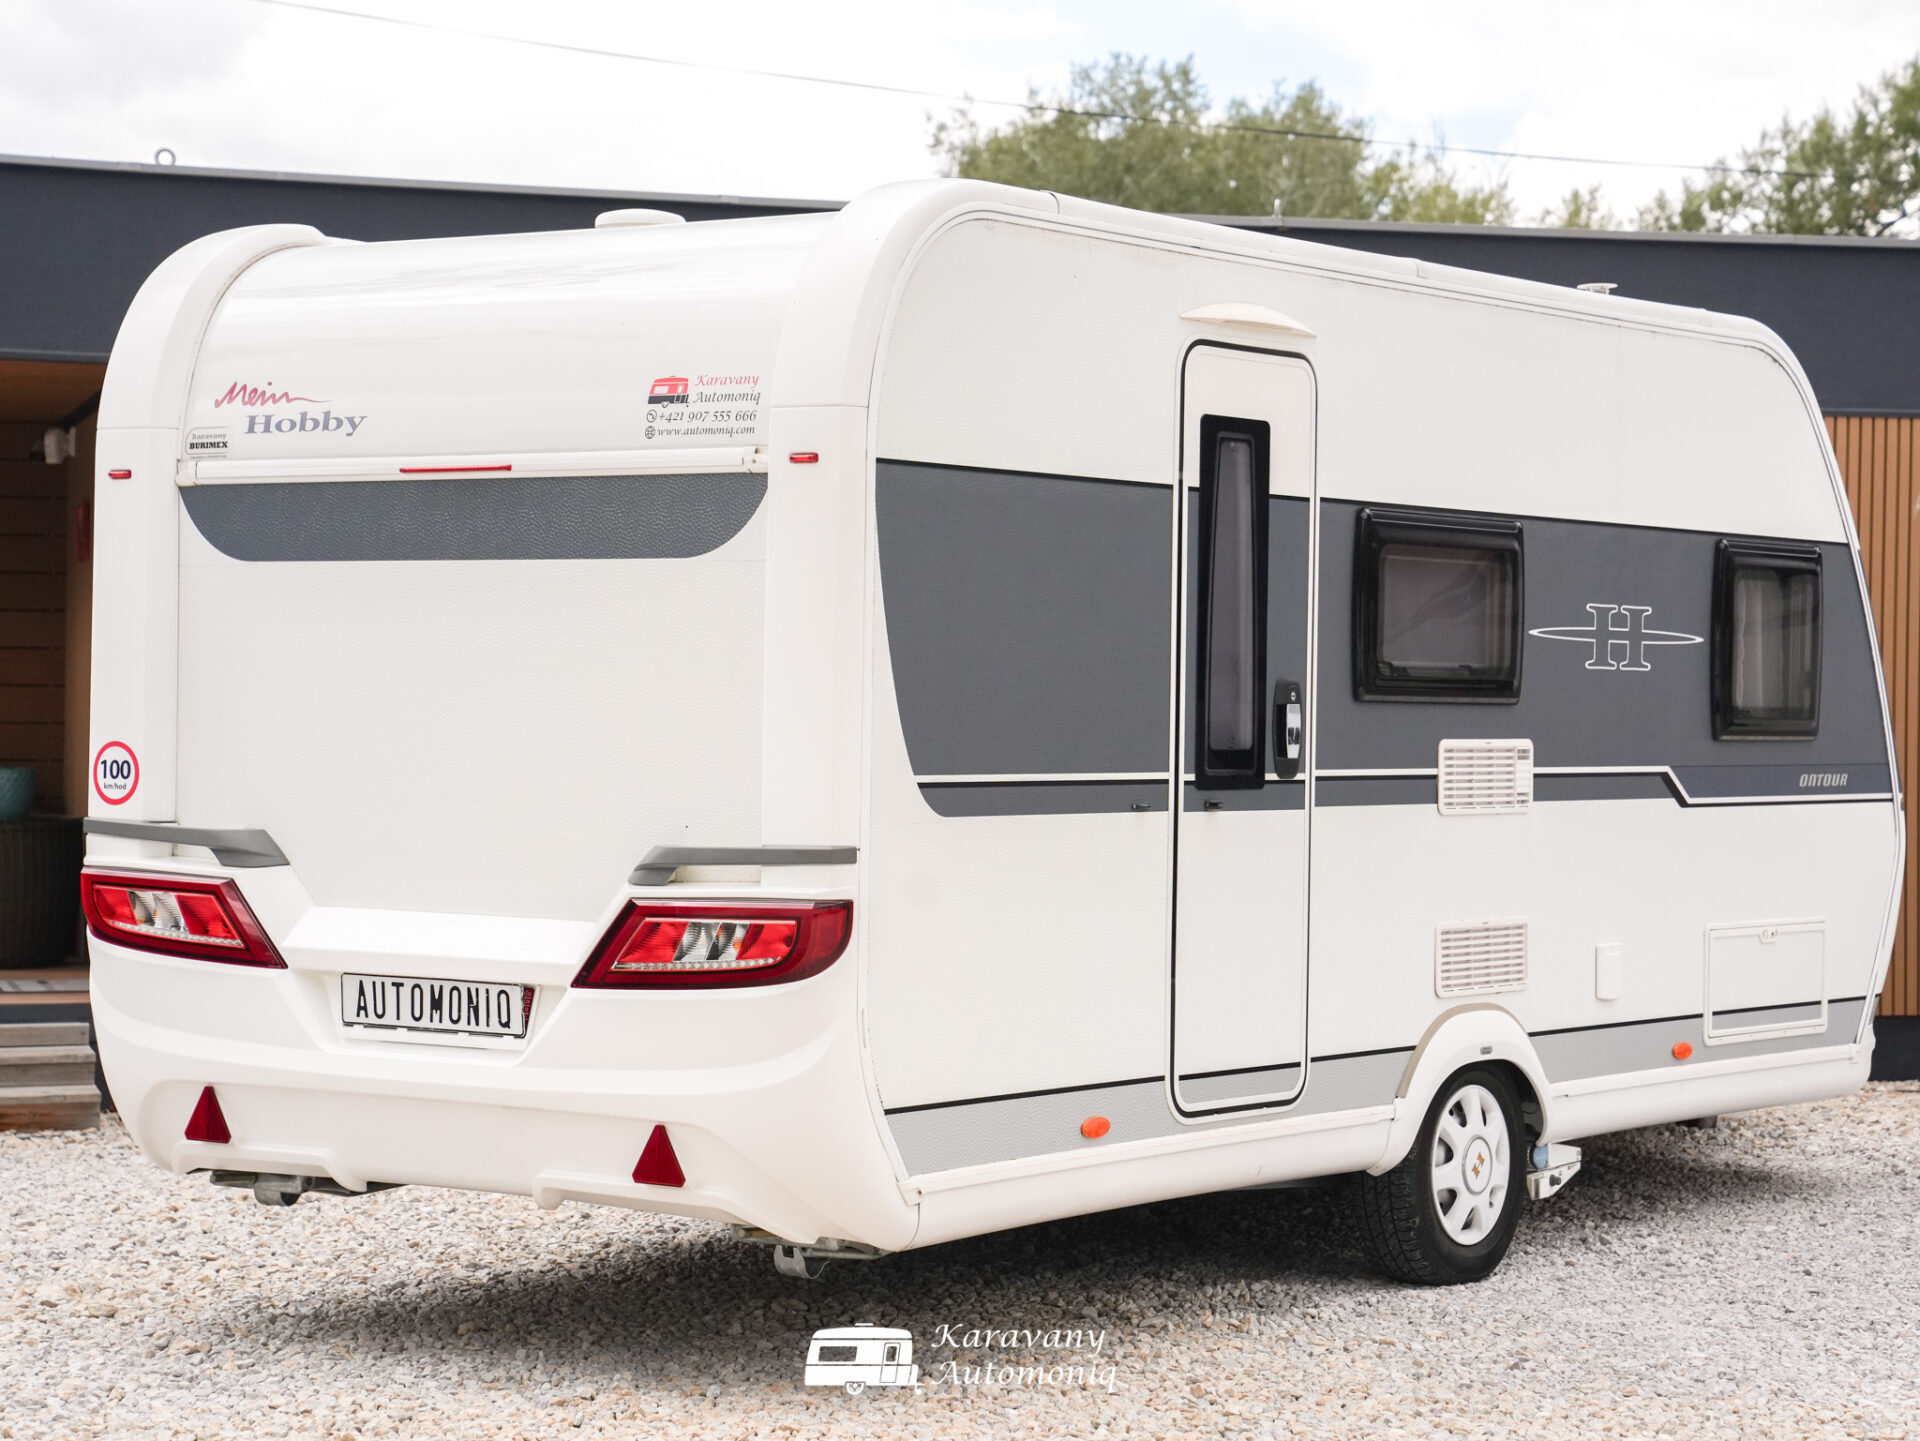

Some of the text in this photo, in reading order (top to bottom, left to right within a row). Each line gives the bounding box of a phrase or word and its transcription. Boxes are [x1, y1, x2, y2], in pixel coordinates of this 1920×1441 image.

[695, 375, 760, 389] Karavany
[214, 381, 332, 408] Mein
[692, 391, 761, 405] Automoniq
[244, 410, 367, 437] Hobby
[658, 410, 757, 423] +421 907 555 666
[657, 426, 755, 438] www.automoniq.com
[189, 441, 228, 449] BURIMEX
[100, 759, 131, 780] 100
[356, 979, 511, 1029] AUTOMONIQ
